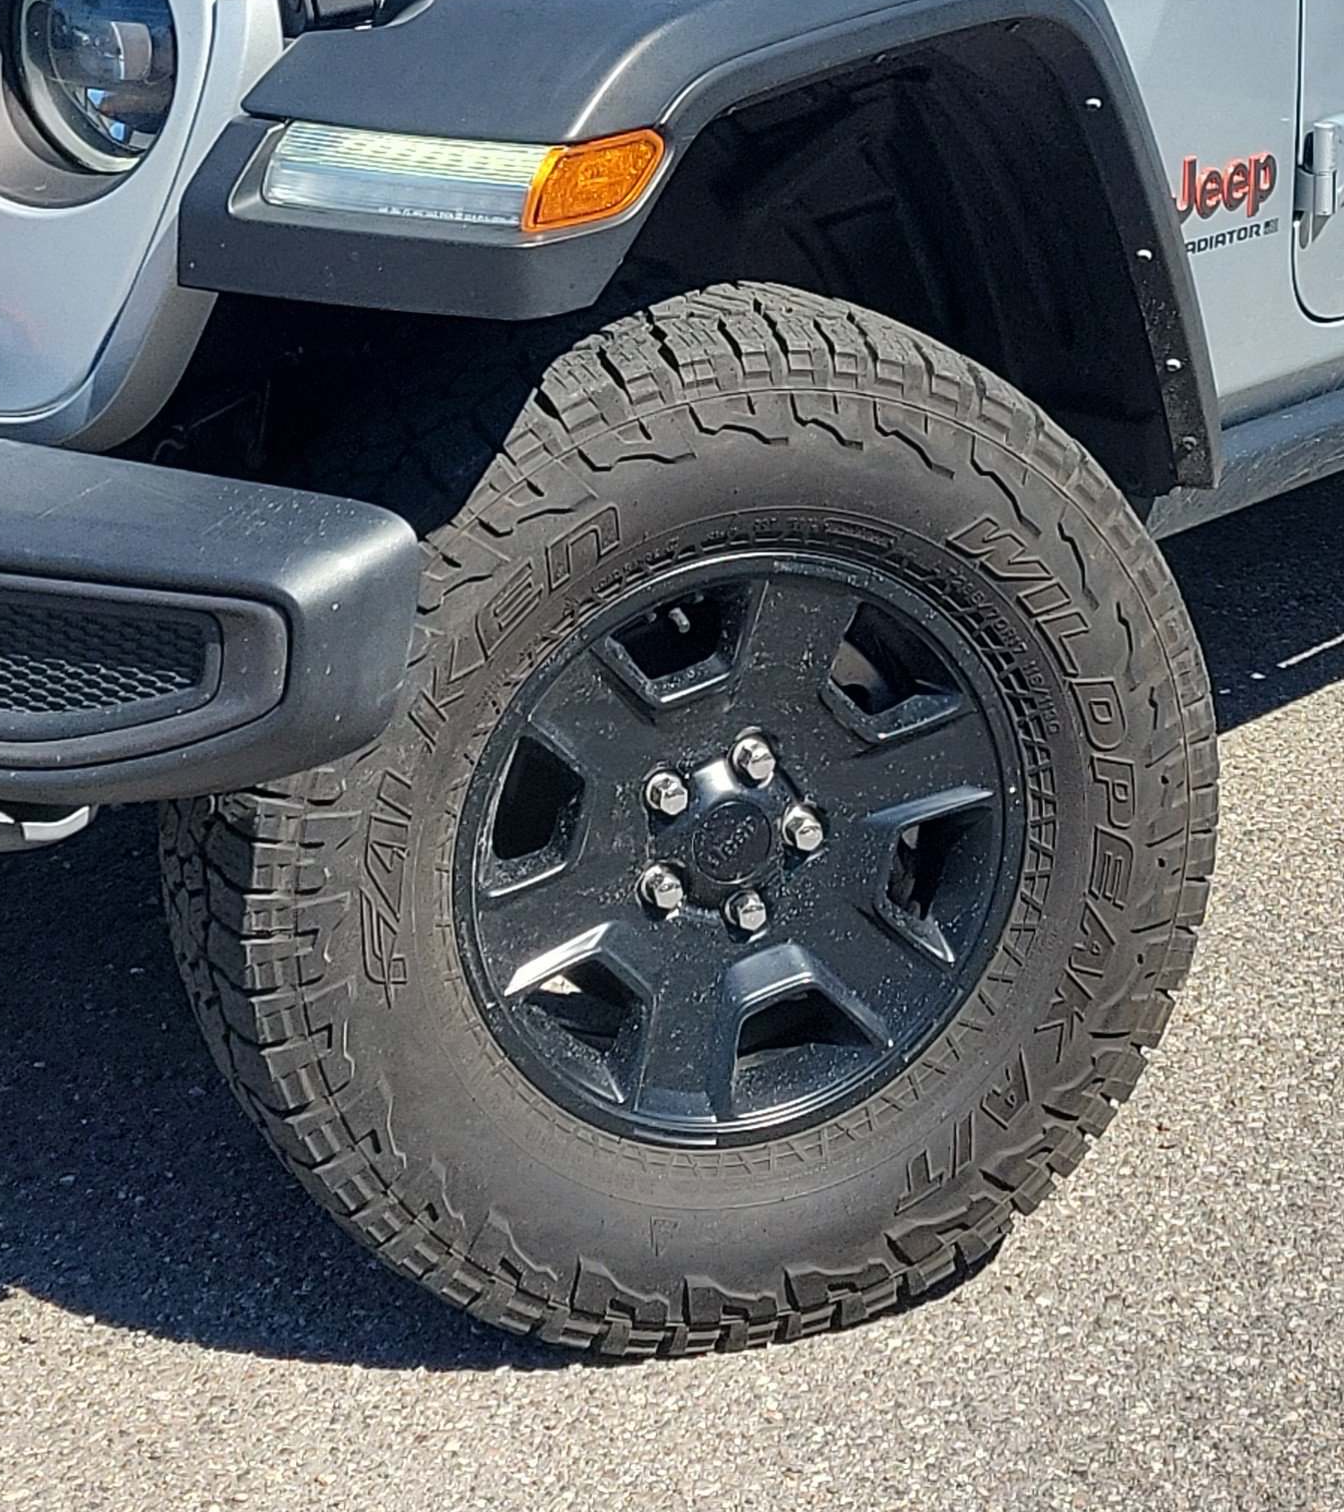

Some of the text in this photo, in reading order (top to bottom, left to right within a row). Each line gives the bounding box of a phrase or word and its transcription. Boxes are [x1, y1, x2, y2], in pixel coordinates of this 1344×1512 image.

[1172, 149, 1278, 225] Jeep
[1185, 223, 1262, 254] ADIATOR
[894, 516, 1135, 1216] WILDPEAK A/T
